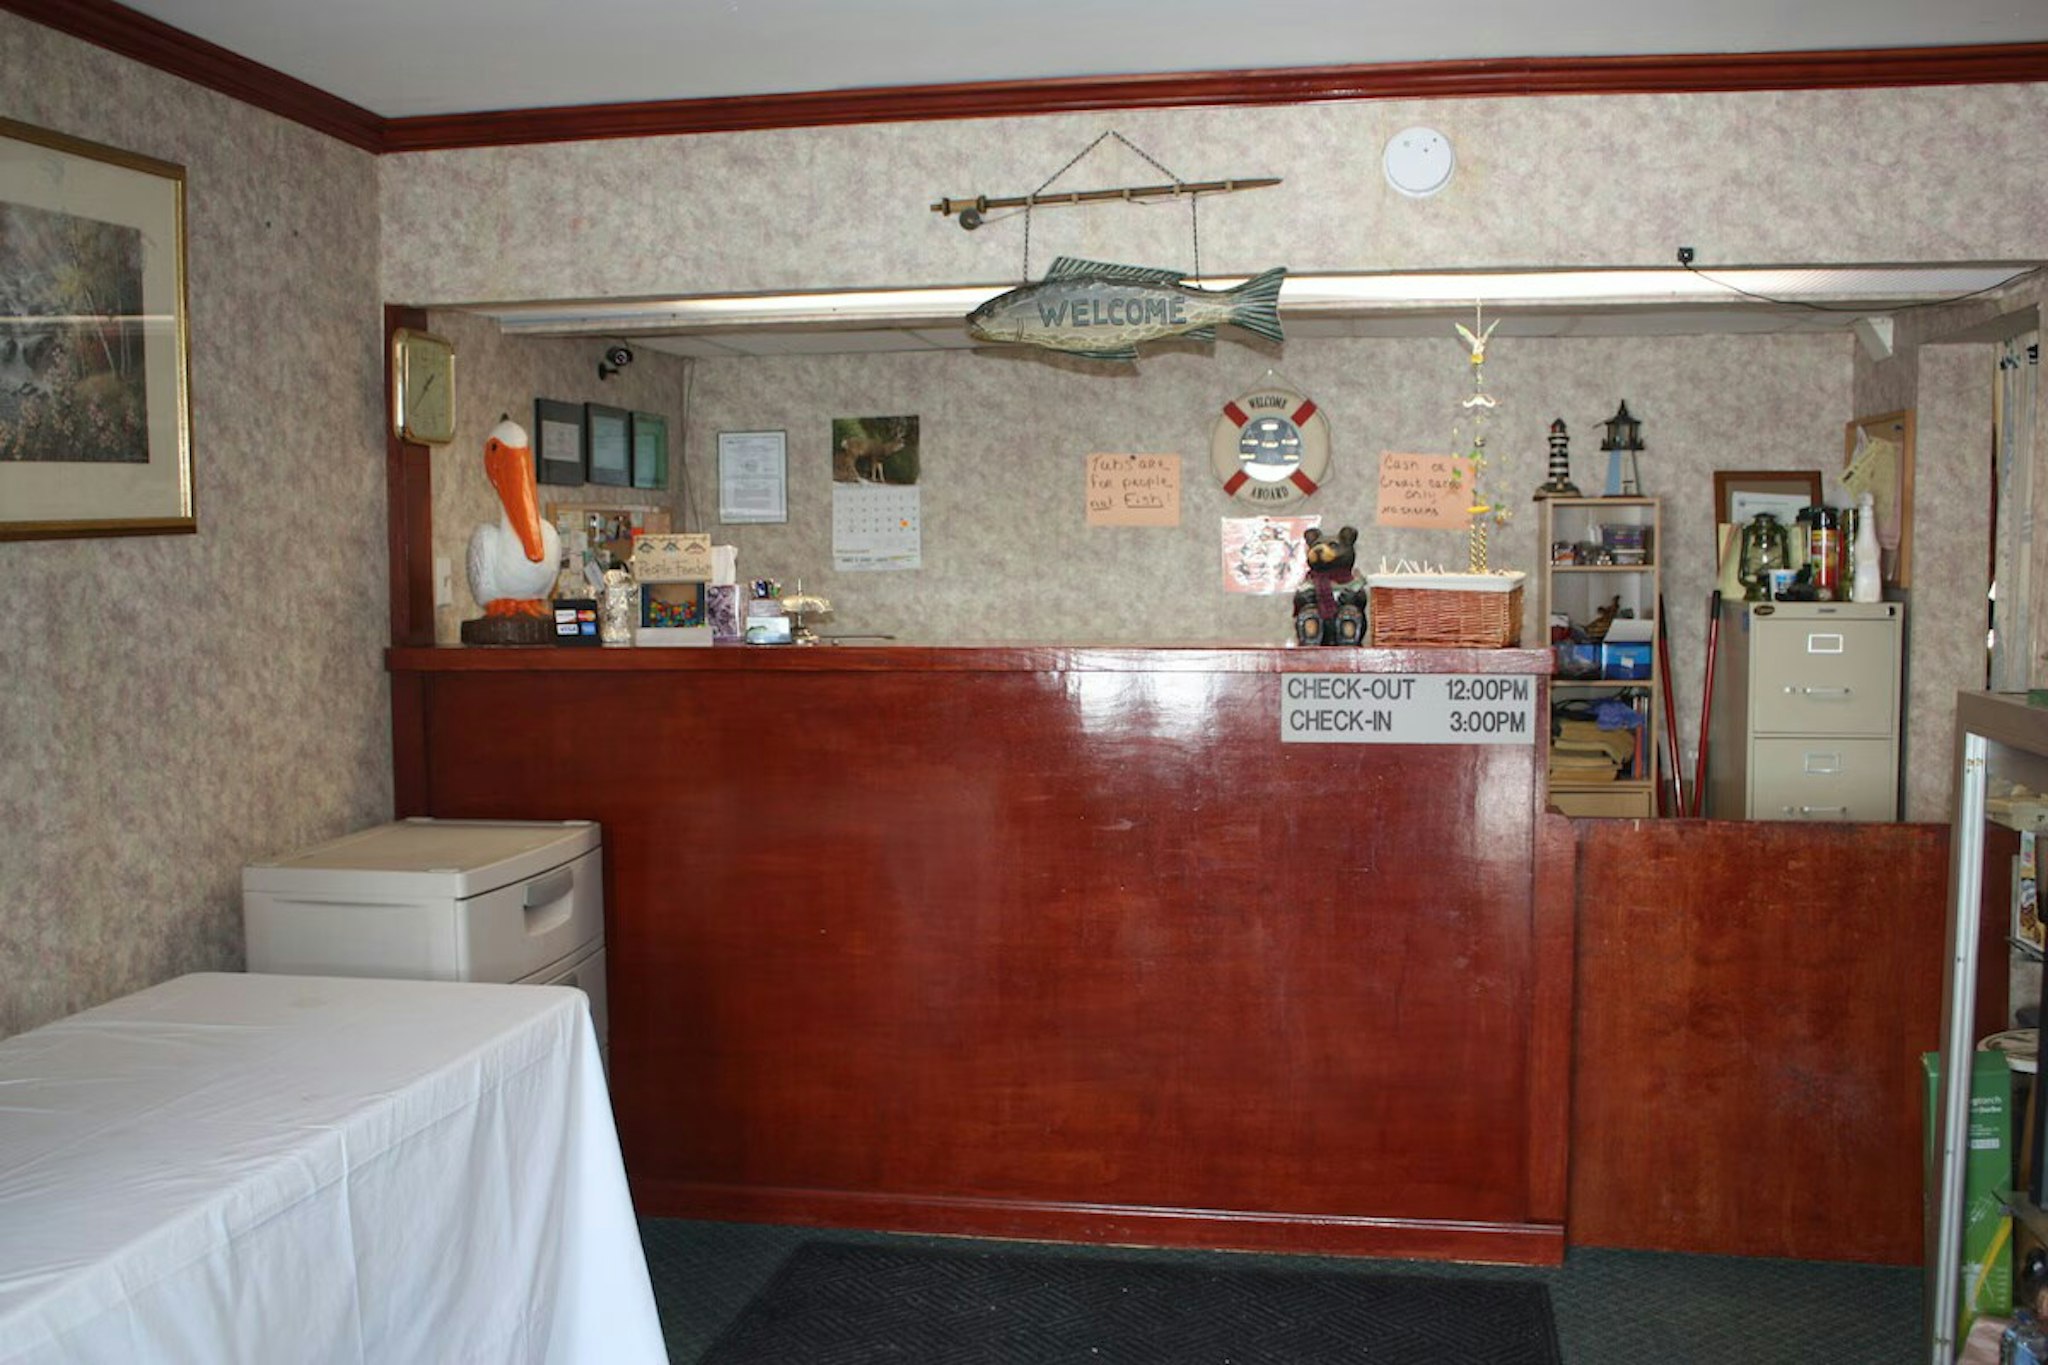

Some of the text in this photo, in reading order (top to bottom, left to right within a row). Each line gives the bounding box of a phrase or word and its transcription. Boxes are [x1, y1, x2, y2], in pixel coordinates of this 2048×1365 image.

[1038, 296, 1187, 327] WELCOME
[1248, 396, 1287, 409] WELCOME
[1384, 453, 1419, 470] Cash
[1251, 486, 1289, 500] ABOARD
[1288, 678, 1528, 701] CHECK-OUT 12:00PM
[1290, 710, 1525, 732] CHECK-IN 3:00PM
